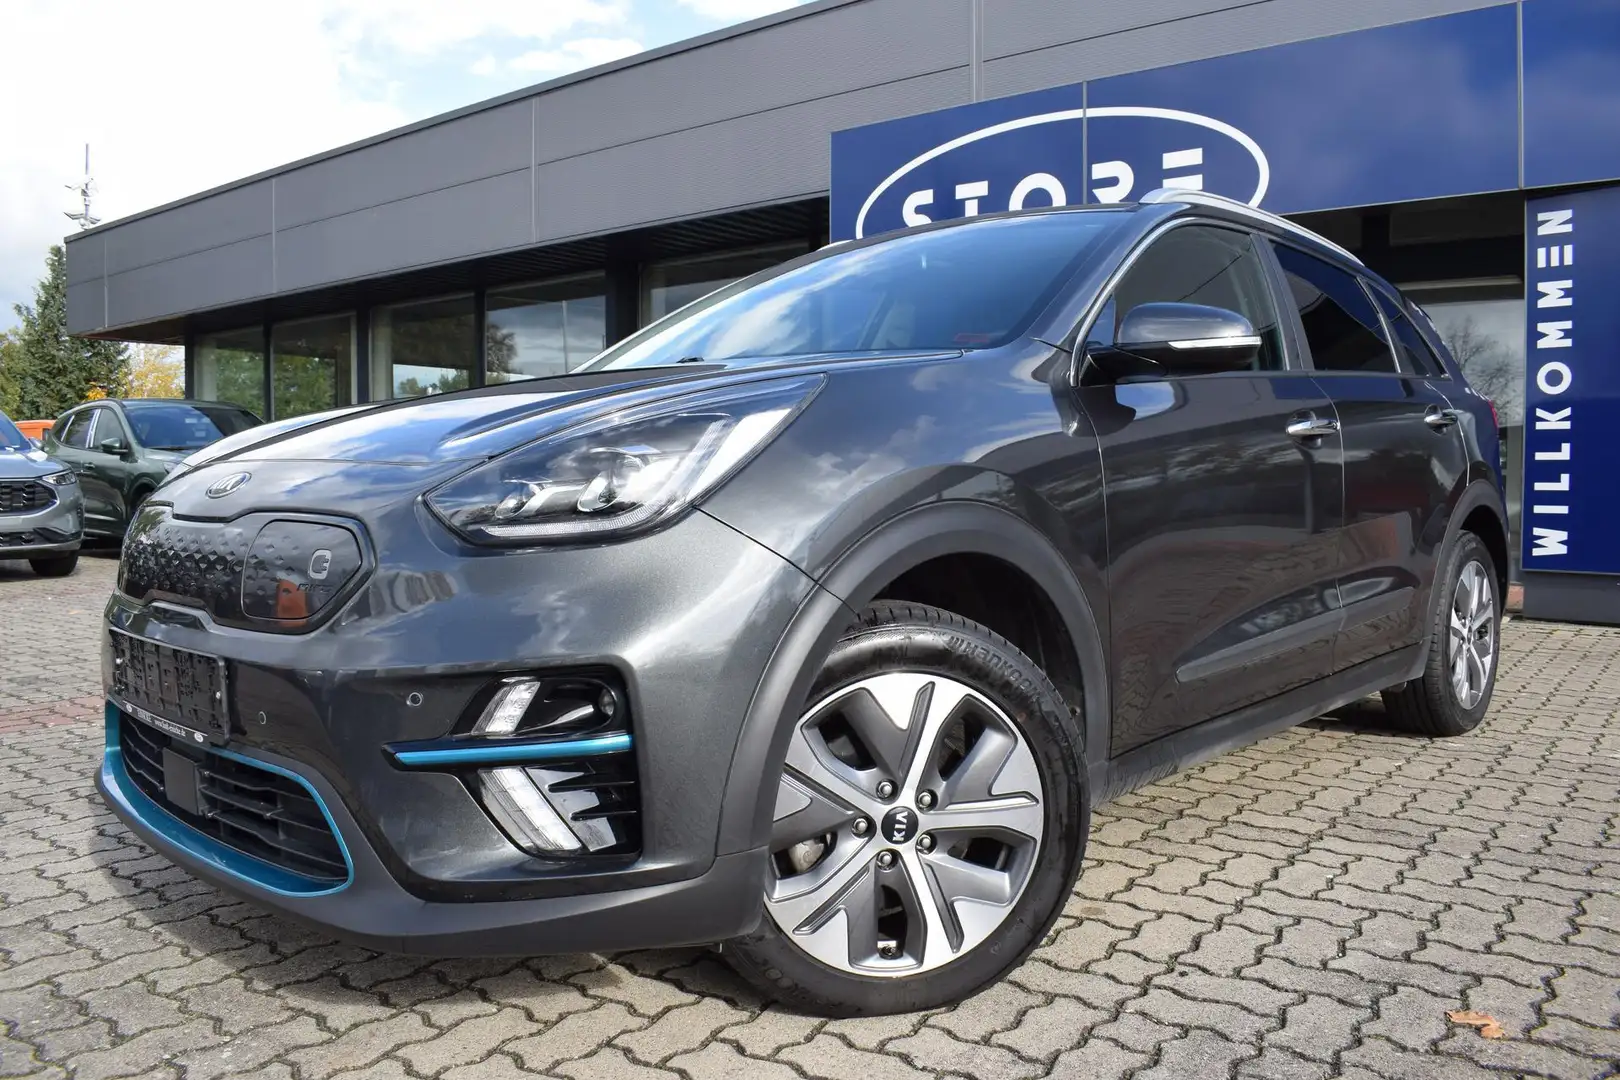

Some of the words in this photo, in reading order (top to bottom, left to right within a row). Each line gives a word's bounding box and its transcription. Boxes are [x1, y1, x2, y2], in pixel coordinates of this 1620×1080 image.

[902, 147, 1203, 228] STORE
[1532, 209, 1574, 556] WILLKOMMEN
[892, 811, 908, 841] KIA
